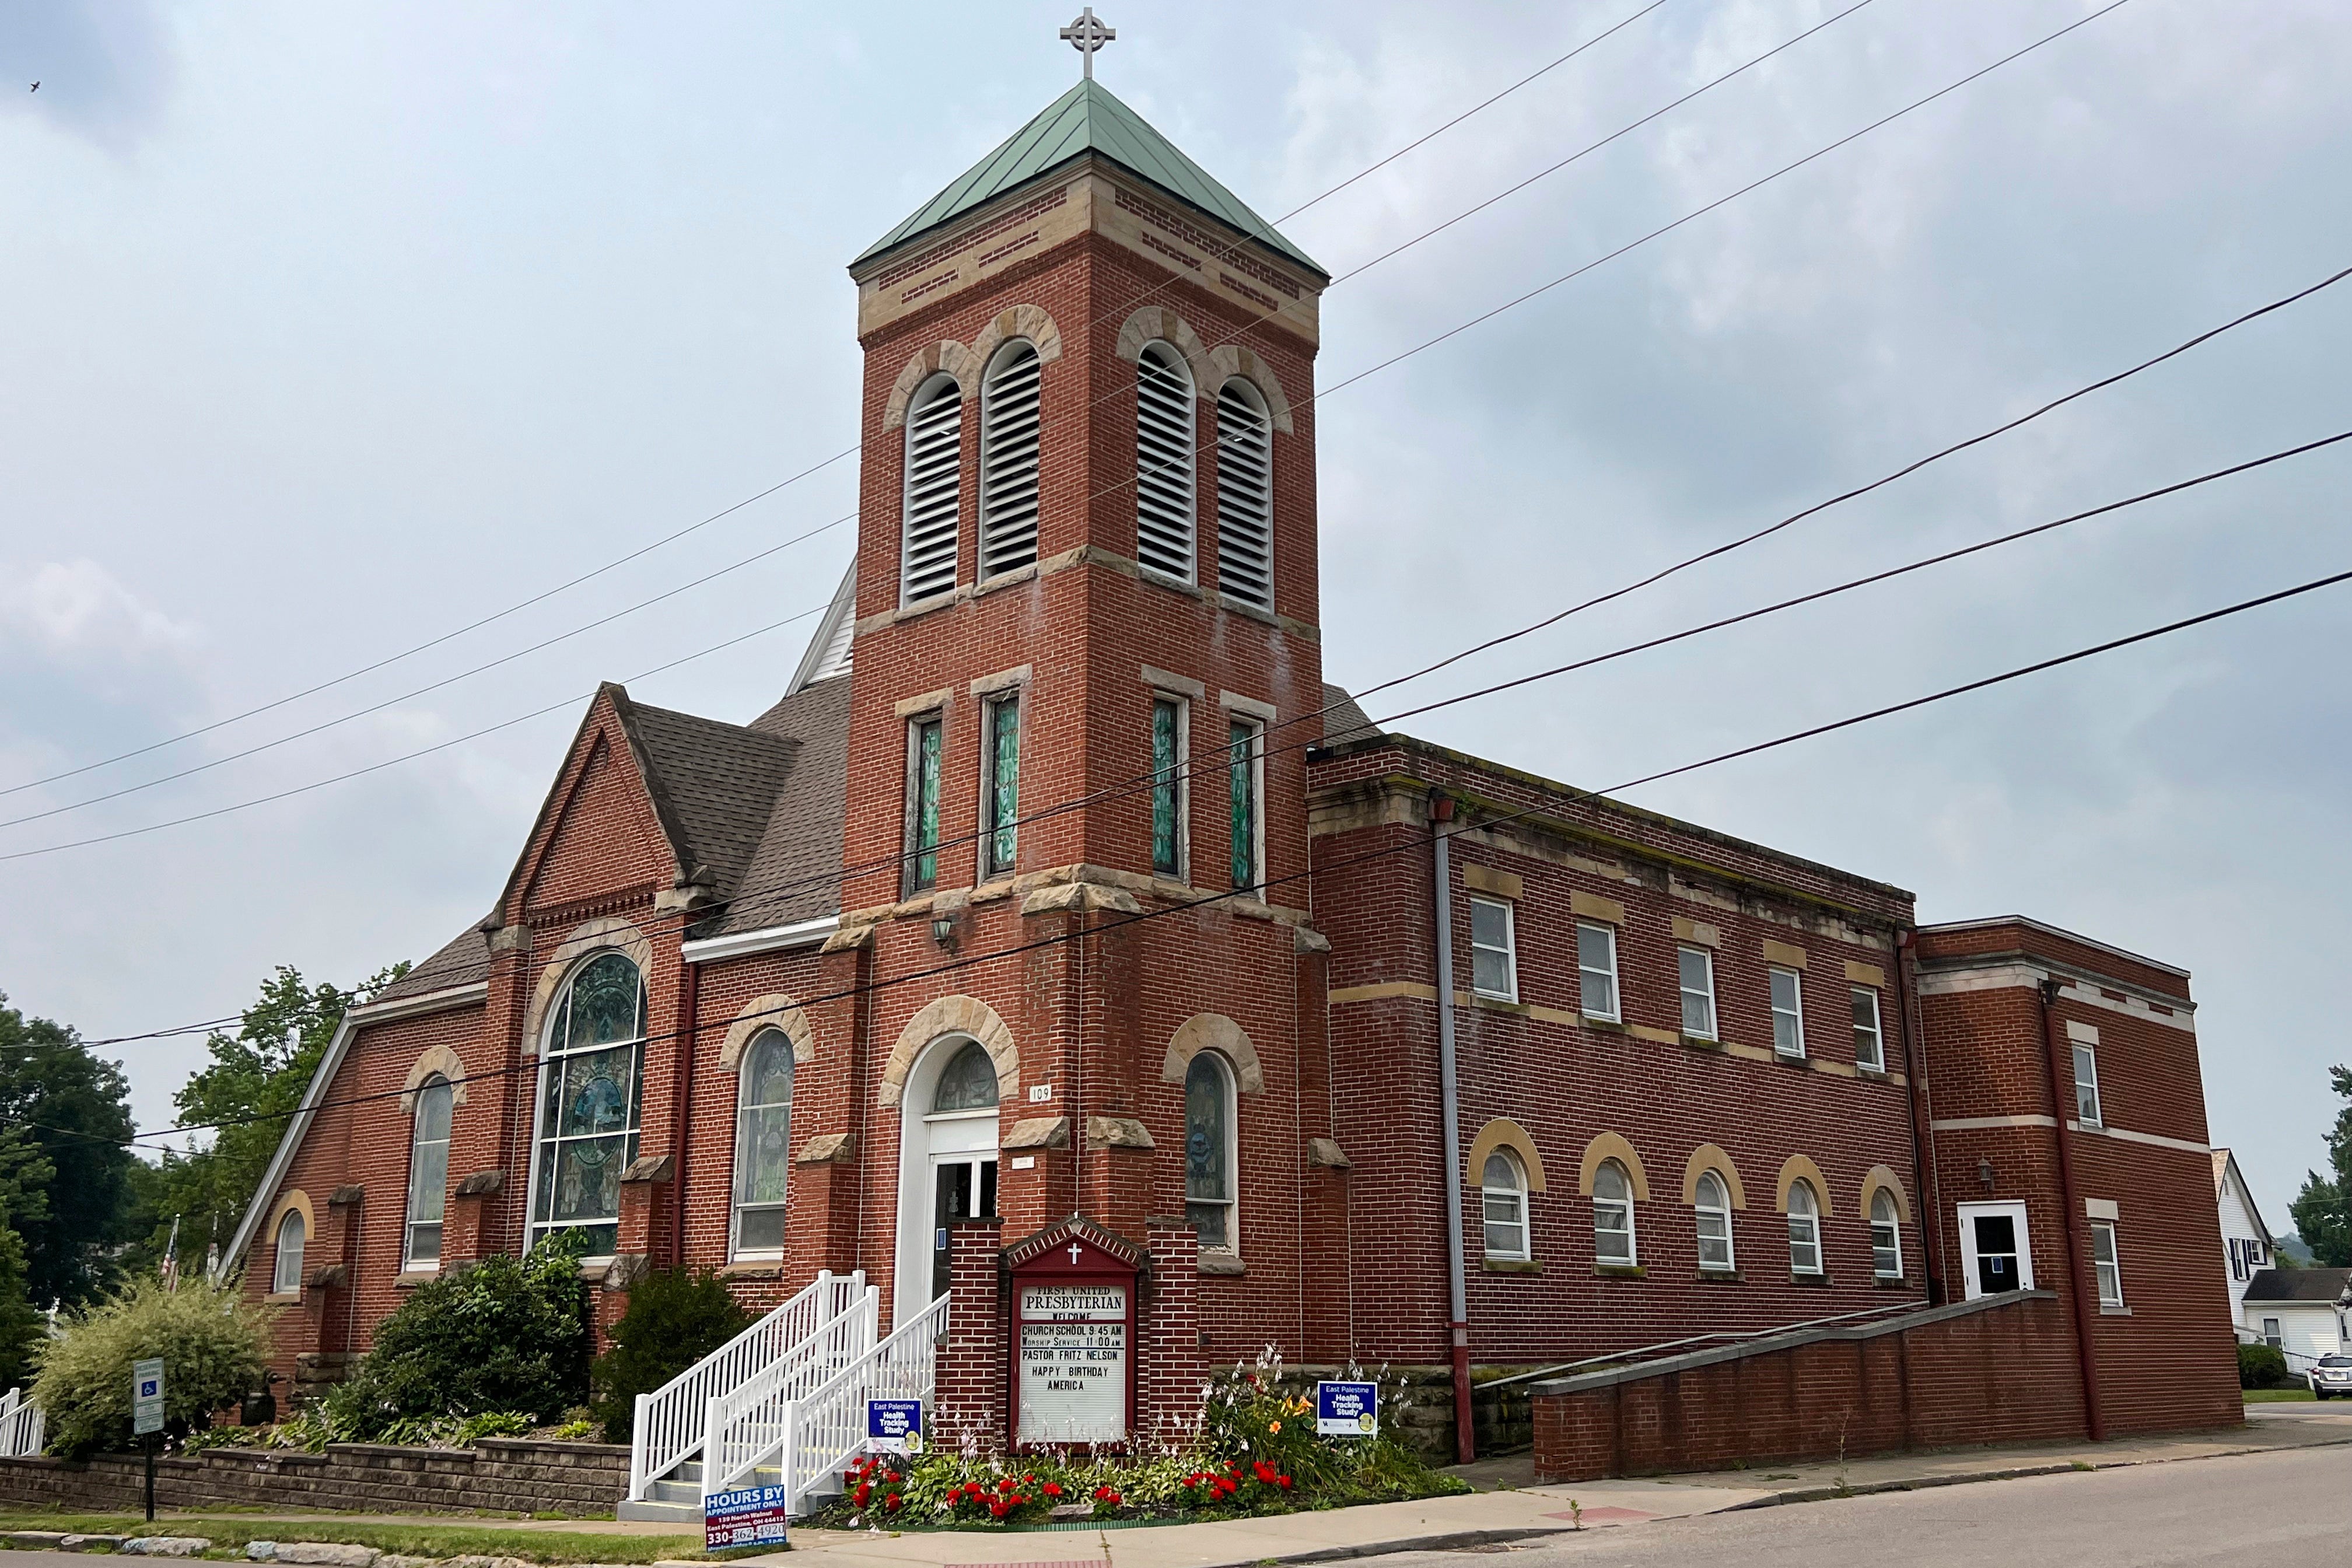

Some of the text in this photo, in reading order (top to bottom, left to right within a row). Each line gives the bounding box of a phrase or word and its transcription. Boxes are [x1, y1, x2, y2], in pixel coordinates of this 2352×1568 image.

[1033, 1087, 1049, 1100] 109
[1037, 1287, 1111, 1295] FIRST UNITED
[1026, 1296, 1122, 1309] PRESBYTERIAN
[1022, 1325, 1054, 1335] CHURCH
[1056, 1325, 1086, 1335] SCHOOL
[1111, 1326, 1122, 1335] AM
[1022, 1350, 1117, 1360] PASTOR FRITZ NELSON
[1032, 1367, 1108, 1377] HAPPY BIRTHDAY
[1048, 1380, 1084, 1390] AMERICA
[1335, 1394, 1360, 1402] Health
[1331, 1401, 1363, 1410] Tracking
[1336, 1408, 1359, 1417] Study
[879, 1419, 909, 1428] Tracking
[884, 1426, 905, 1436] Study
[706, 1486, 783, 1509] HOURS BY
[706, 1499, 783, 1517] APPOINTMENT ONLY
[731, 1513, 750, 1521] North
[750, 1510, 773, 1518] Walnut
[722, 1521, 752, 1530] Palestine,
